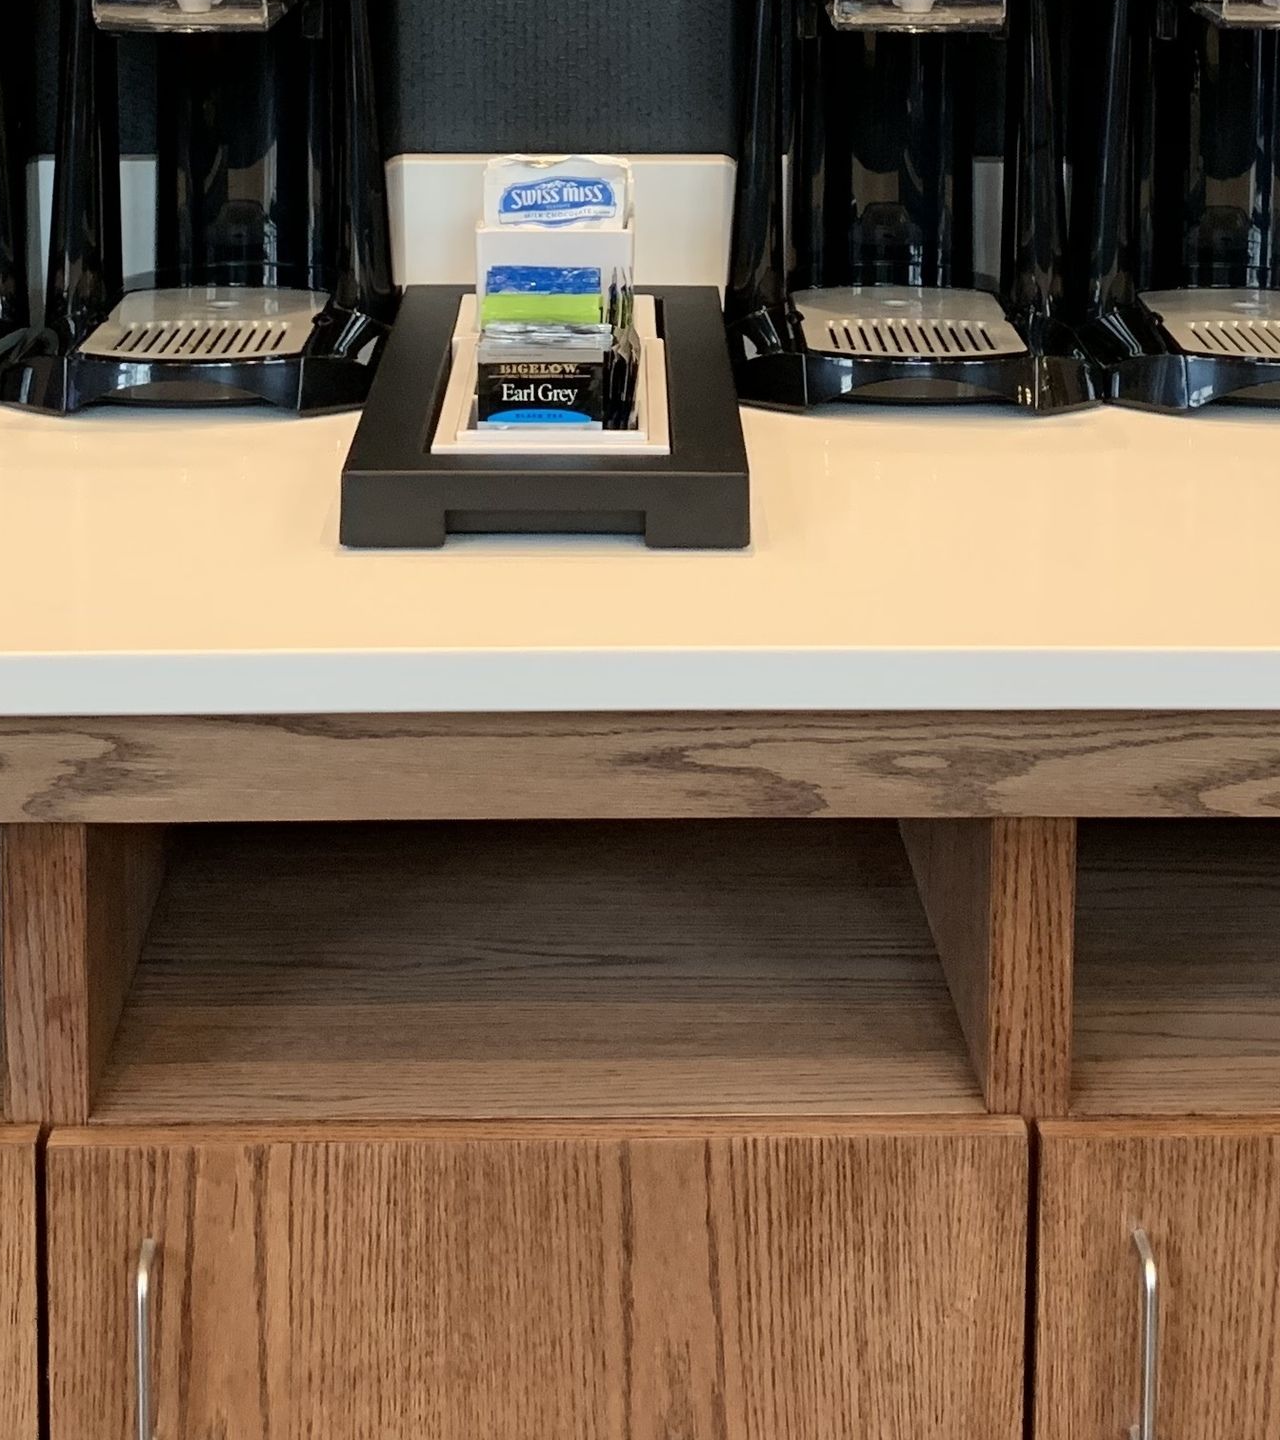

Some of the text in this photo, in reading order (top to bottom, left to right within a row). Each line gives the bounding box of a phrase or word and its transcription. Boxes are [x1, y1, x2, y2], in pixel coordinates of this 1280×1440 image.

[499, 363, 578, 374] BIGELOW
[501, 383, 578, 405] Earl Grey
